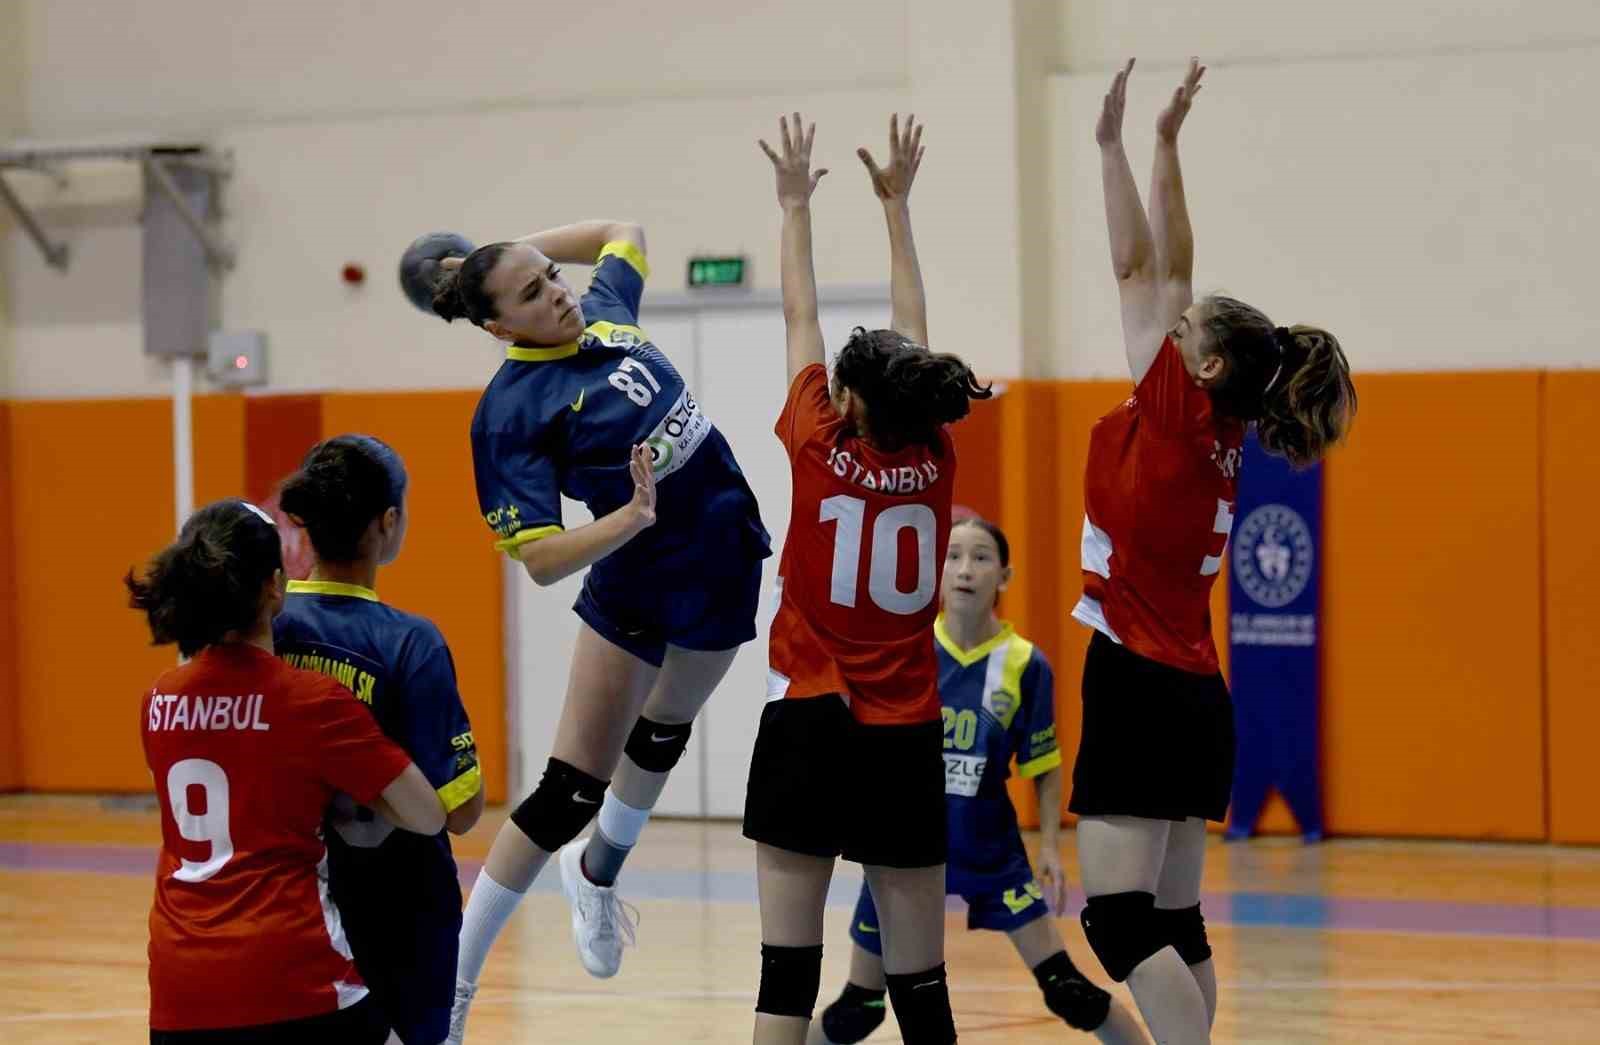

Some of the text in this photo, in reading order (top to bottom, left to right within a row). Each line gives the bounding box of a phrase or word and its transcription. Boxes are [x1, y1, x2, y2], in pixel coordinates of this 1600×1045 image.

[607, 356, 663, 408] 87
[819, 494, 938, 615] 10
[148, 687, 270, 732] İSTANBUL
[355, 670, 377, 705] SK
[940, 706, 978, 751] 20
[166, 757, 234, 883] 9
